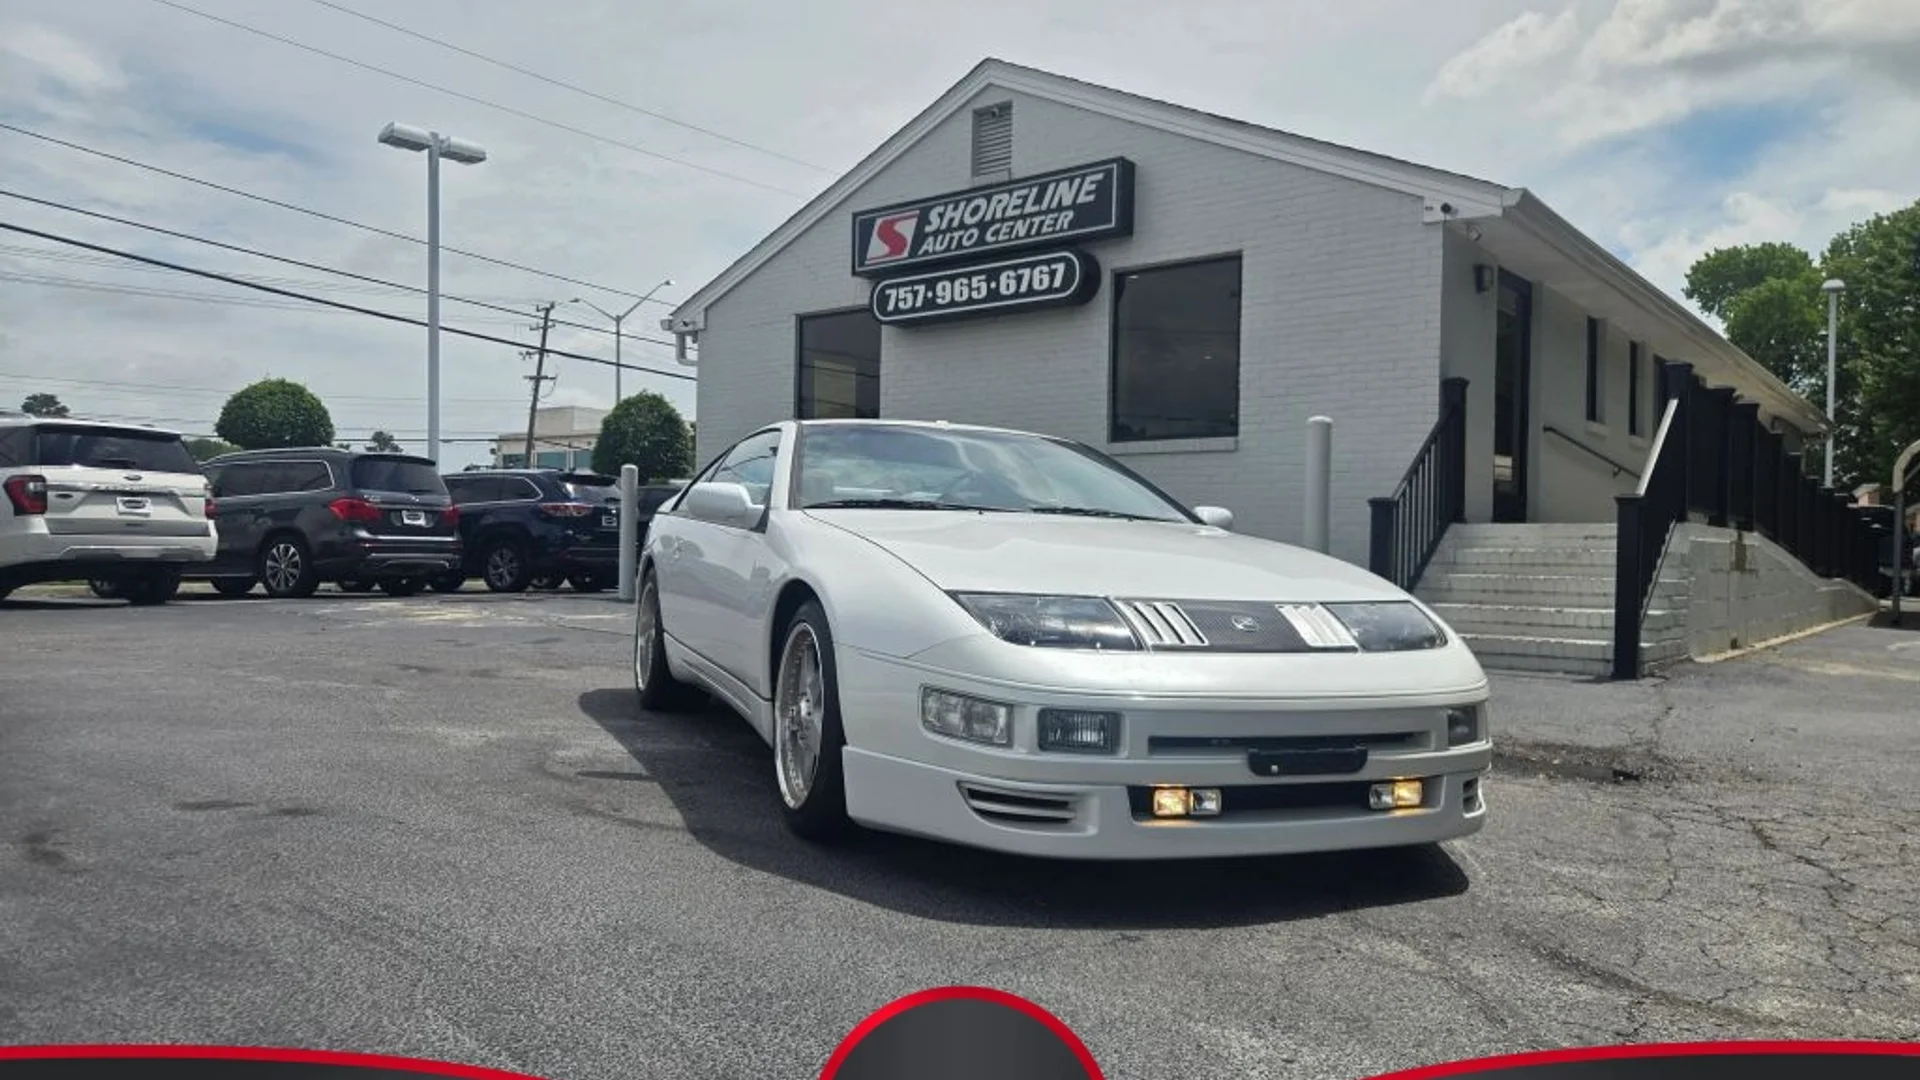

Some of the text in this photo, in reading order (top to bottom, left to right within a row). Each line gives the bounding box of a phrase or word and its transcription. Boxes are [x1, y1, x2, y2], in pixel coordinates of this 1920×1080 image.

[924, 172, 1104, 233] SHORELINE
[918, 210, 1074, 255] AUTO CENTER
